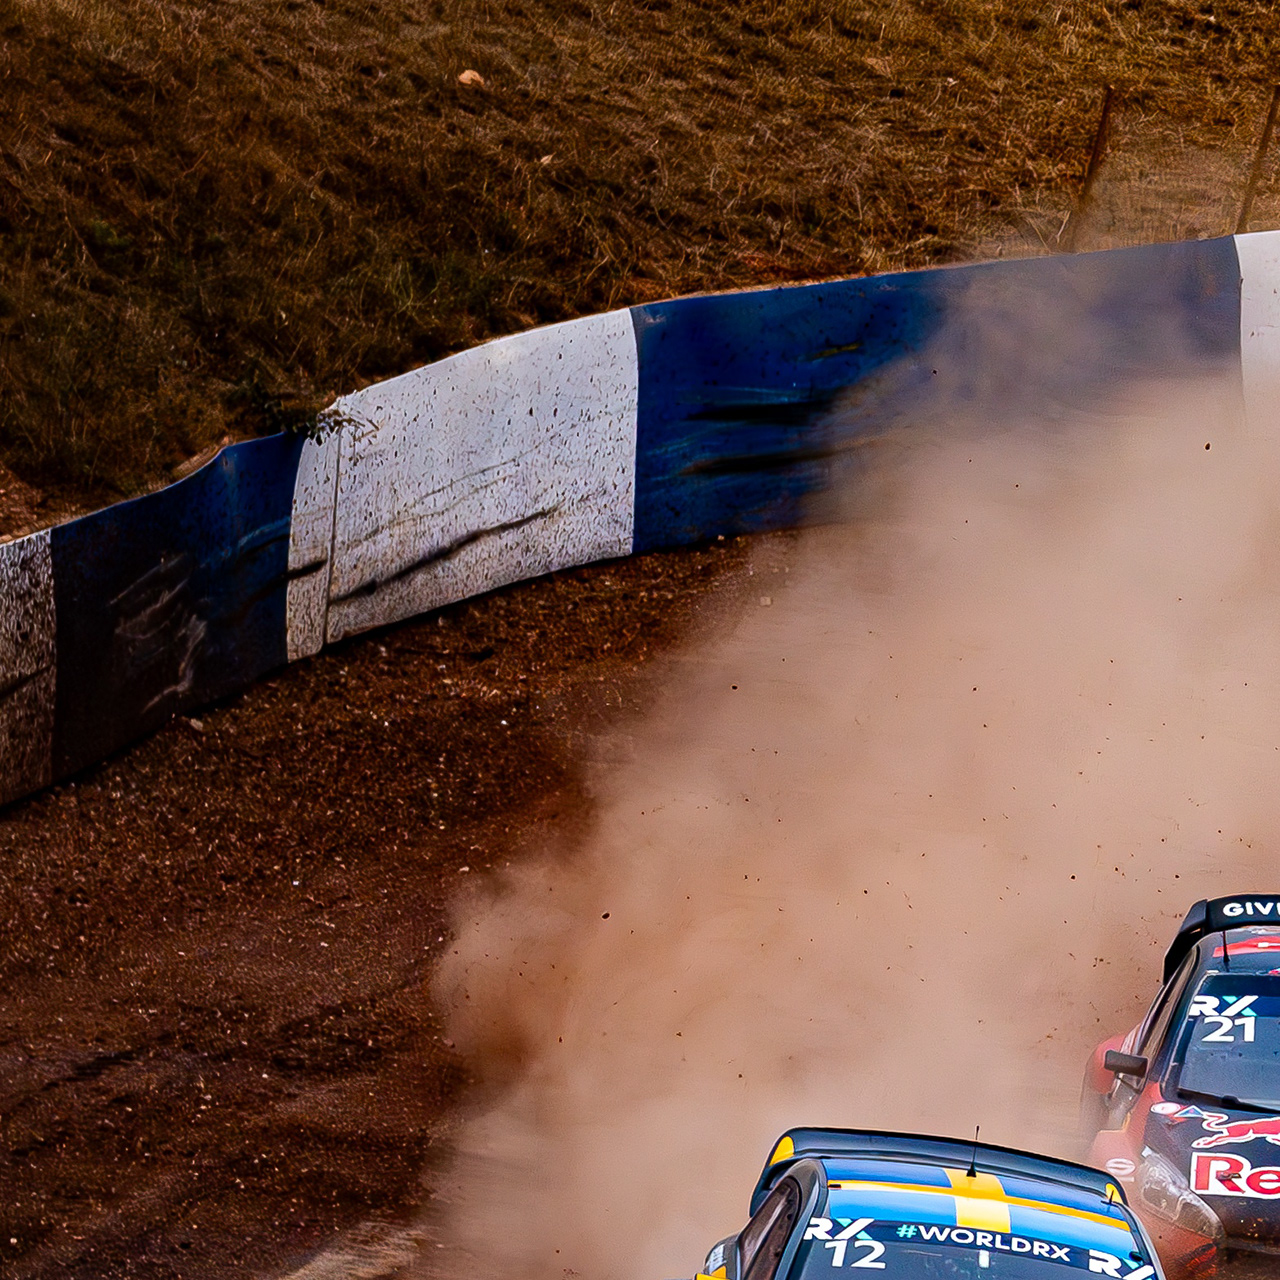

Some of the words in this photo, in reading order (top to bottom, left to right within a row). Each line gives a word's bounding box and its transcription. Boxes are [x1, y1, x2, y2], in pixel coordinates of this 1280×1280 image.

[1189, 995, 1259, 1017] RX
[1200, 1016, 1256, 1043] 21
[803, 1217, 875, 1240] RX
[824, 1239, 888, 1270] 12
[897, 1222, 1072, 1263] #WORLDRX
